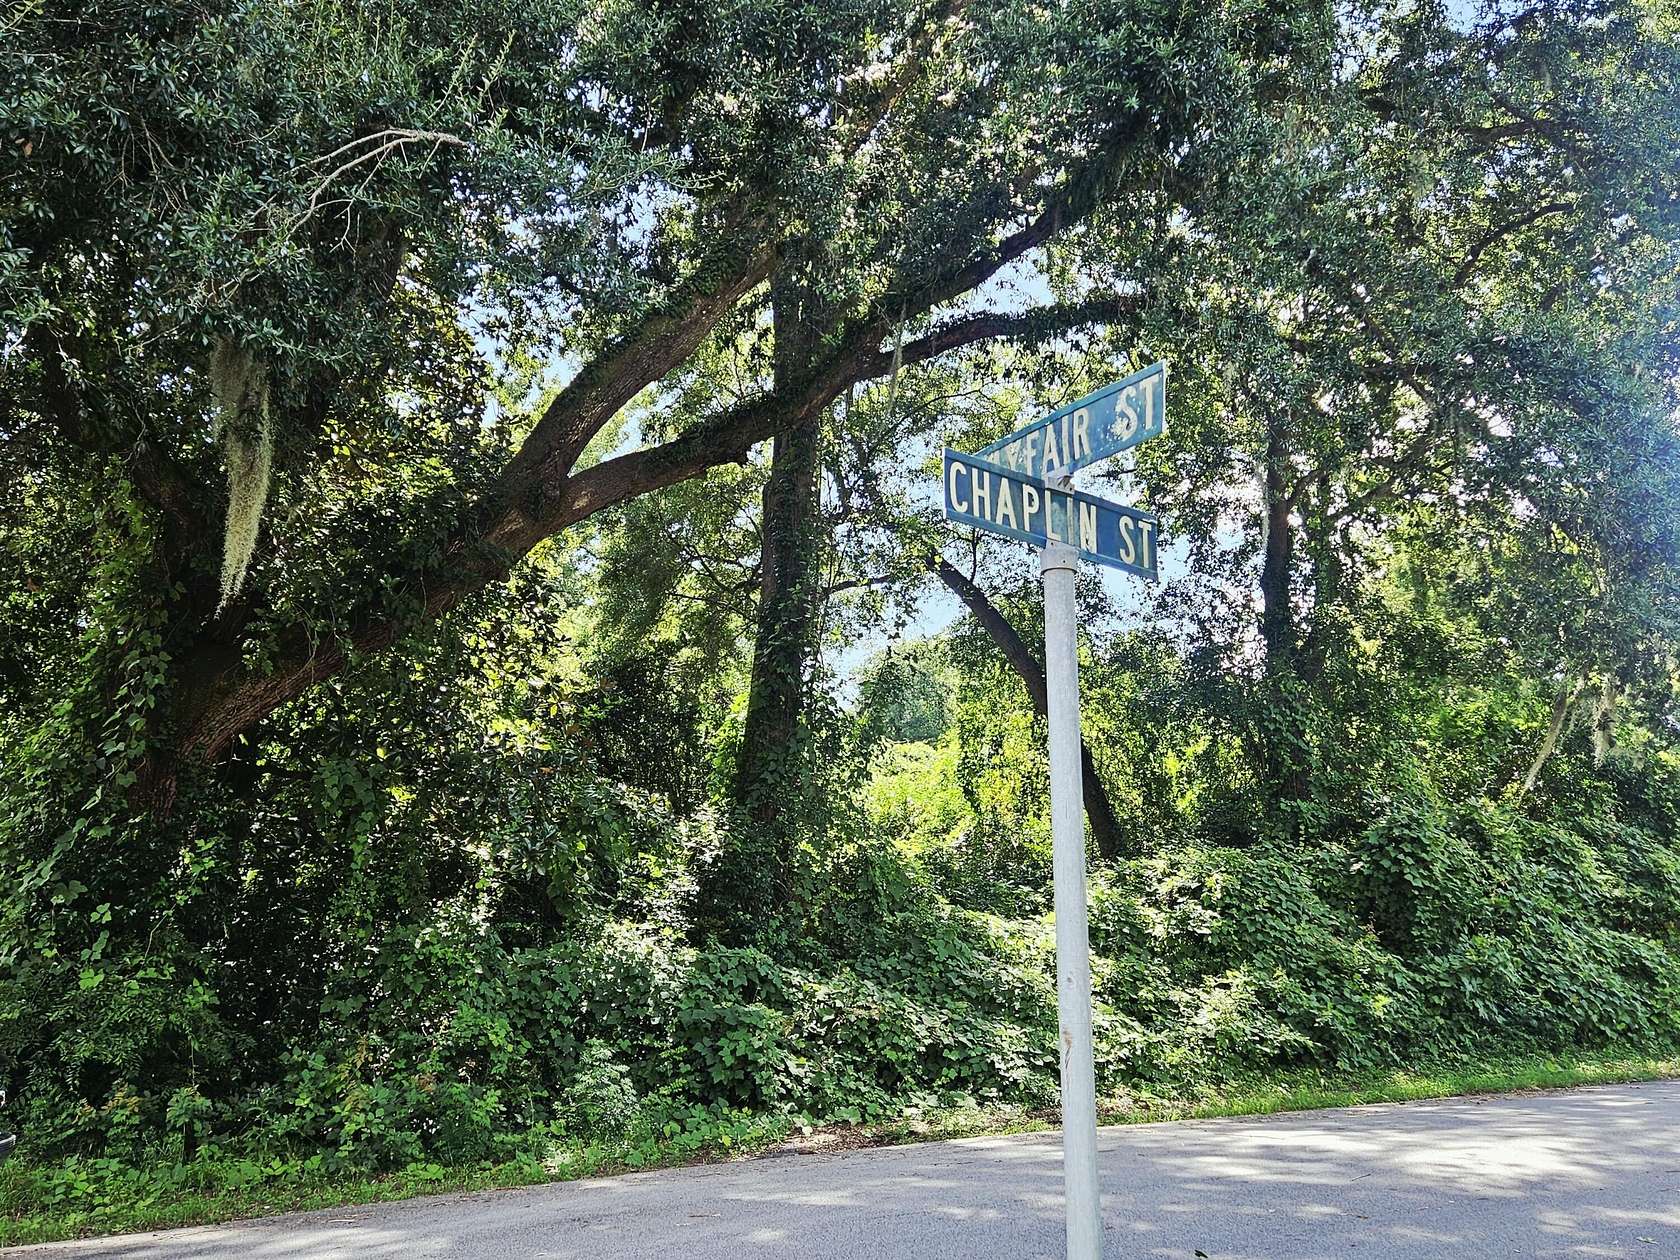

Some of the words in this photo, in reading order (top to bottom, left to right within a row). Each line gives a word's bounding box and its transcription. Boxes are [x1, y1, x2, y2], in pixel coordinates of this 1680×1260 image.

[1112, 373, 1160, 441] ST
[949, 461, 1098, 554] CHAPLIN
[1119, 515, 1152, 569] ST
